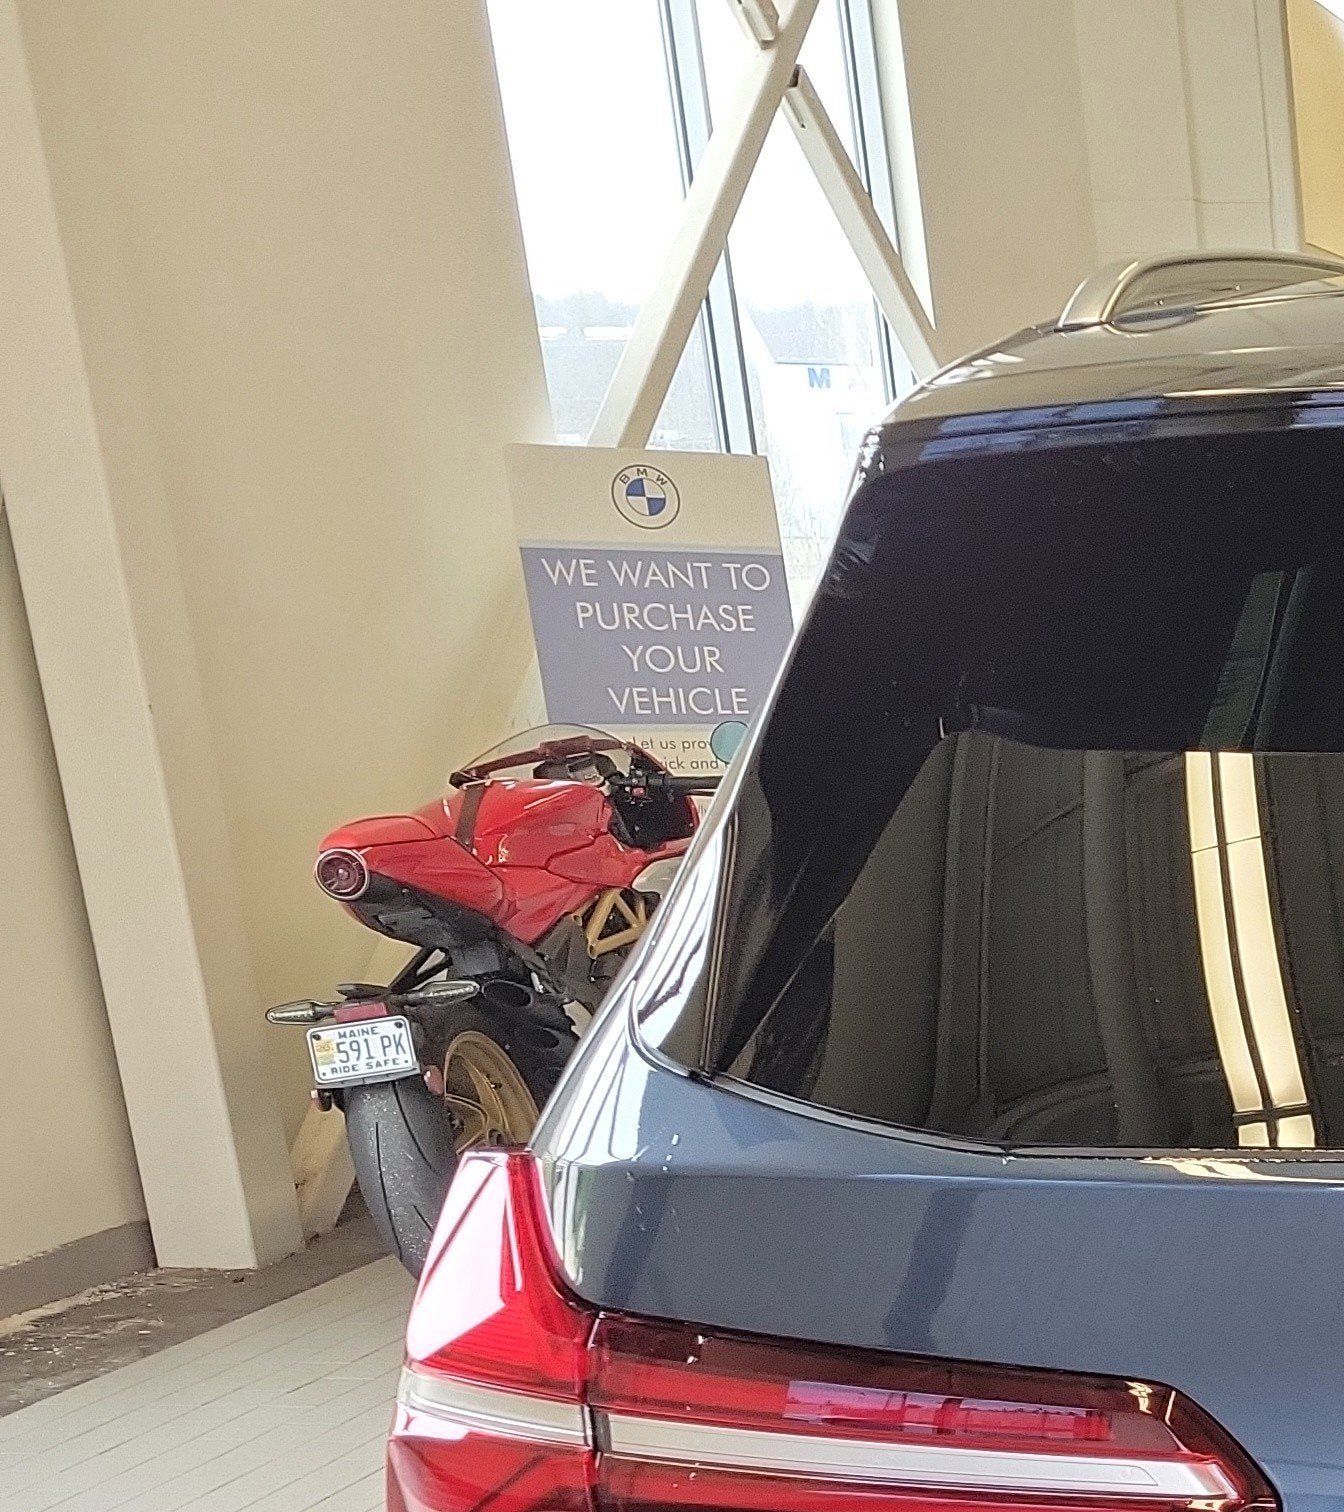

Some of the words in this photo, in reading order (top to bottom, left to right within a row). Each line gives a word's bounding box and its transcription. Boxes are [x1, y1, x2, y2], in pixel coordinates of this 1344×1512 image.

[808, 368, 831, 389] M
[619, 467, 669, 487] BMW
[541, 558, 598, 587] WE
[607, 560, 712, 590] WANT
[722, 562, 771, 591] TO
[576, 602, 757, 632] PURCHASE
[622, 645, 724, 674] YOUR
[607, 687, 750, 715] VEHICLE
[660, 740, 676, 750] us
[690, 755, 719, 770] and
[337, 1026, 380, 1040] MAINE
[336, 1037, 375, 1064] 591
[380, 1033, 406, 1057] PK
[331, 1064, 359, 1076] RIDE
[366, 1058, 400, 1070] SAFE
